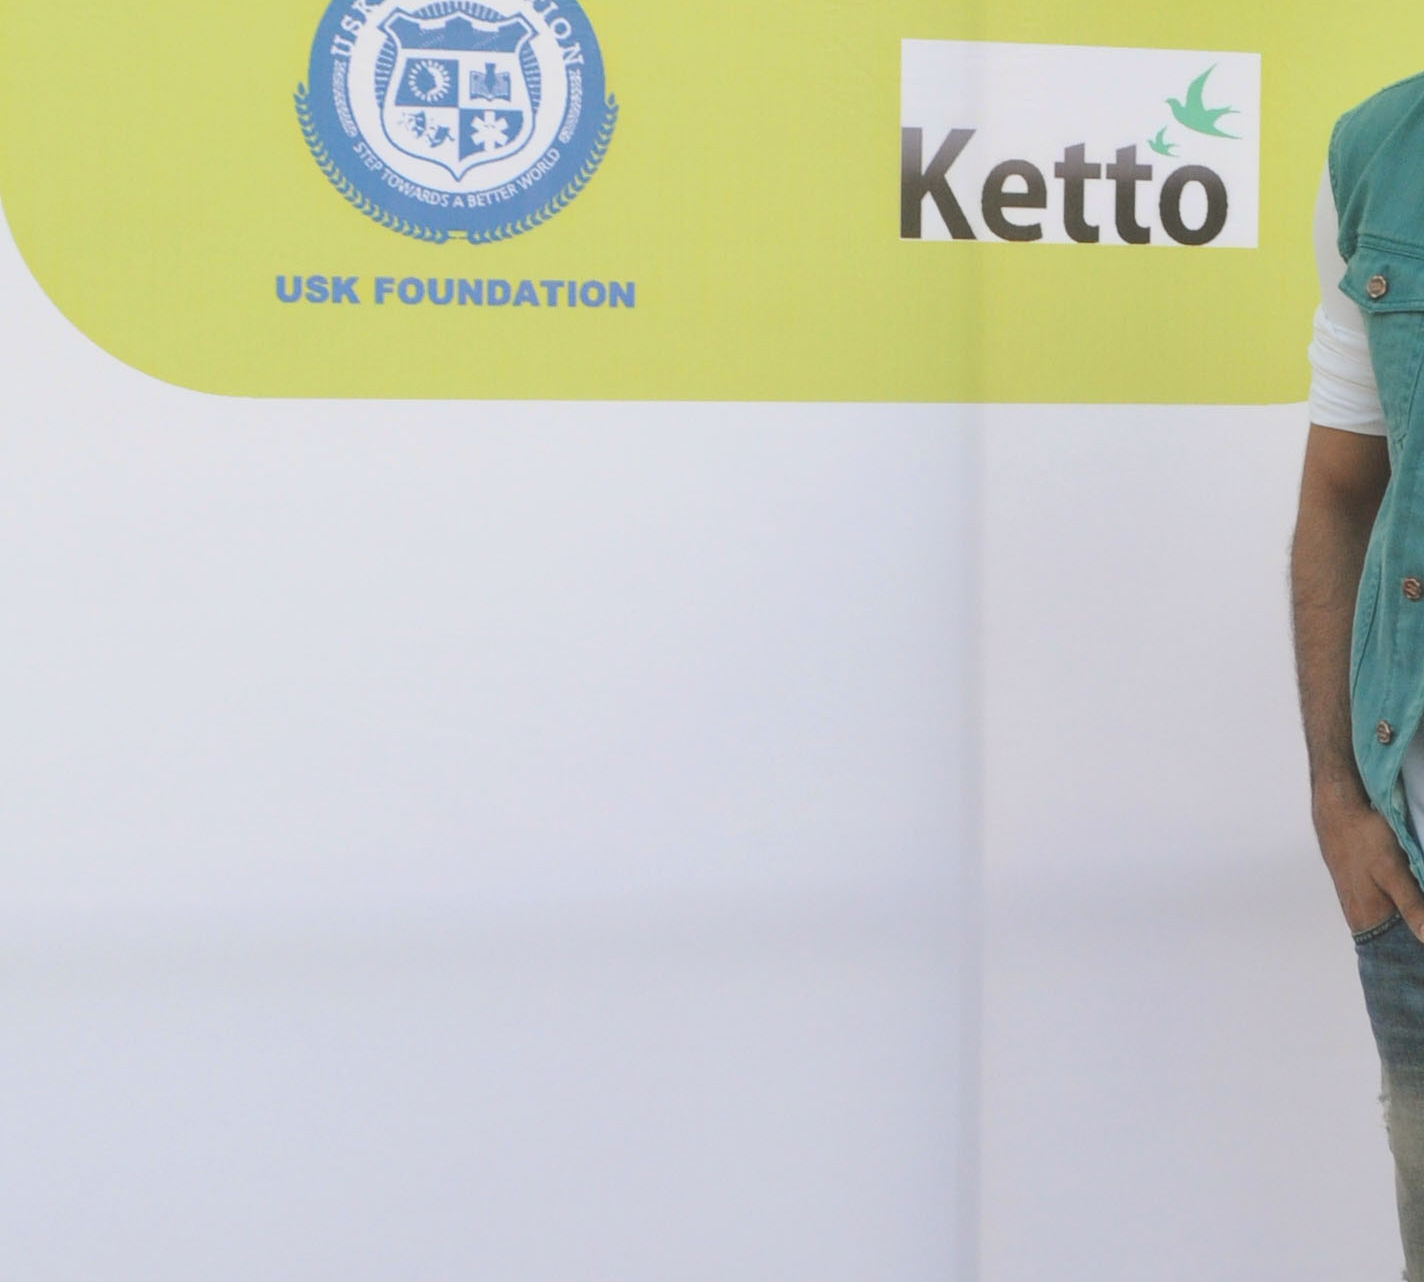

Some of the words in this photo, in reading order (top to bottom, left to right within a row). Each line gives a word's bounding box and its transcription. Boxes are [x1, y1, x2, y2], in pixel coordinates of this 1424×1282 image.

[353, 141, 383, 171] STEP
[381, 168, 450, 208] TOWARDS
[453, 196, 464, 208] A
[467, 183, 520, 208] BETTER
[517, 148, 561, 190] WORLD
[900, 126, 1228, 246] Ketto
[275, 275, 361, 305] USK
[374, 277, 636, 309] FOUNDATION
